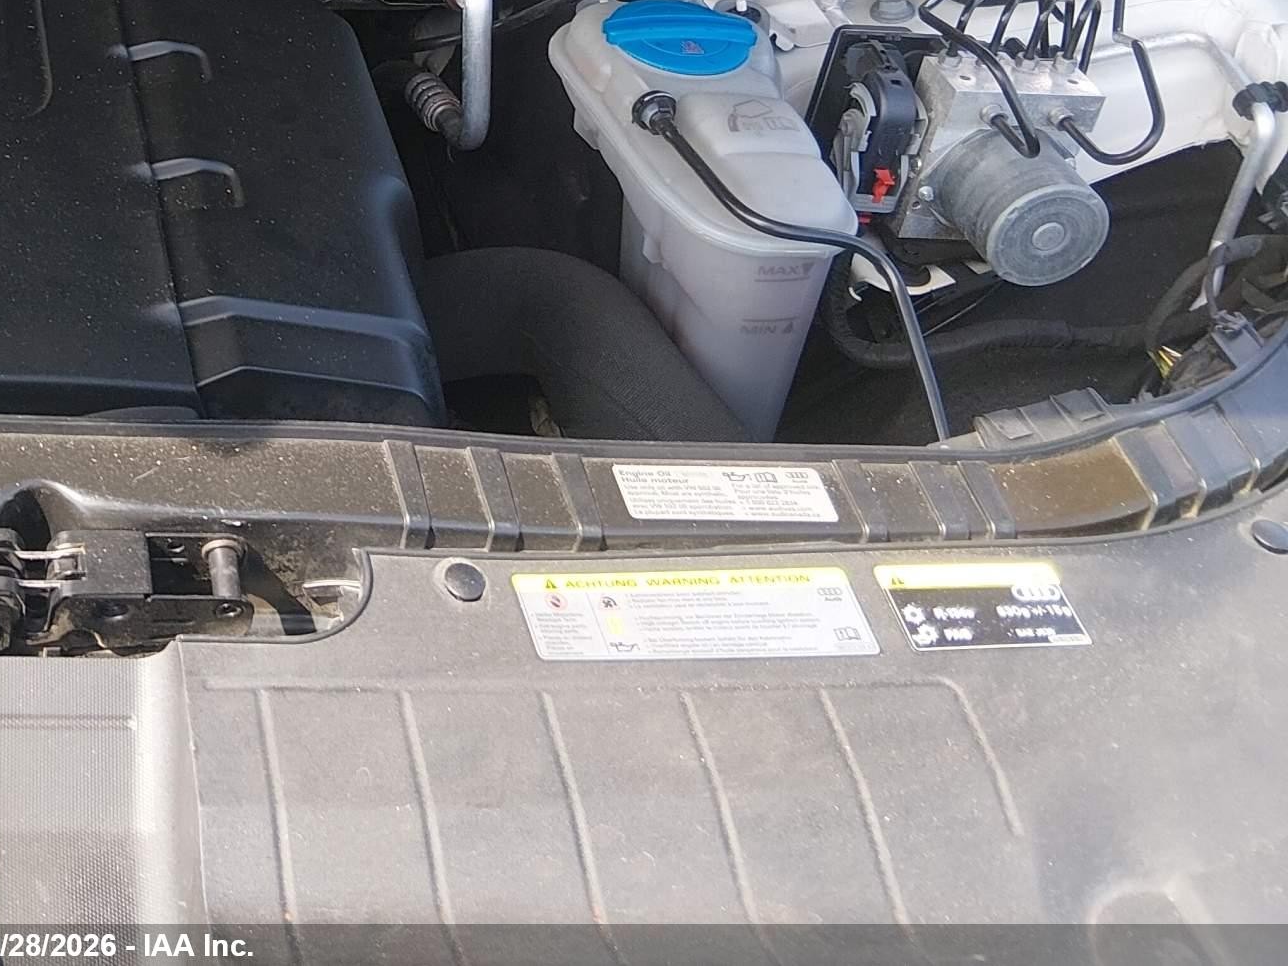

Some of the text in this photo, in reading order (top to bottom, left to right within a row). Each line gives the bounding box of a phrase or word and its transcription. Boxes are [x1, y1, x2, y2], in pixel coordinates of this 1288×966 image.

[565, 575, 810, 588] ACHTUNG WARNING ATTENTION
